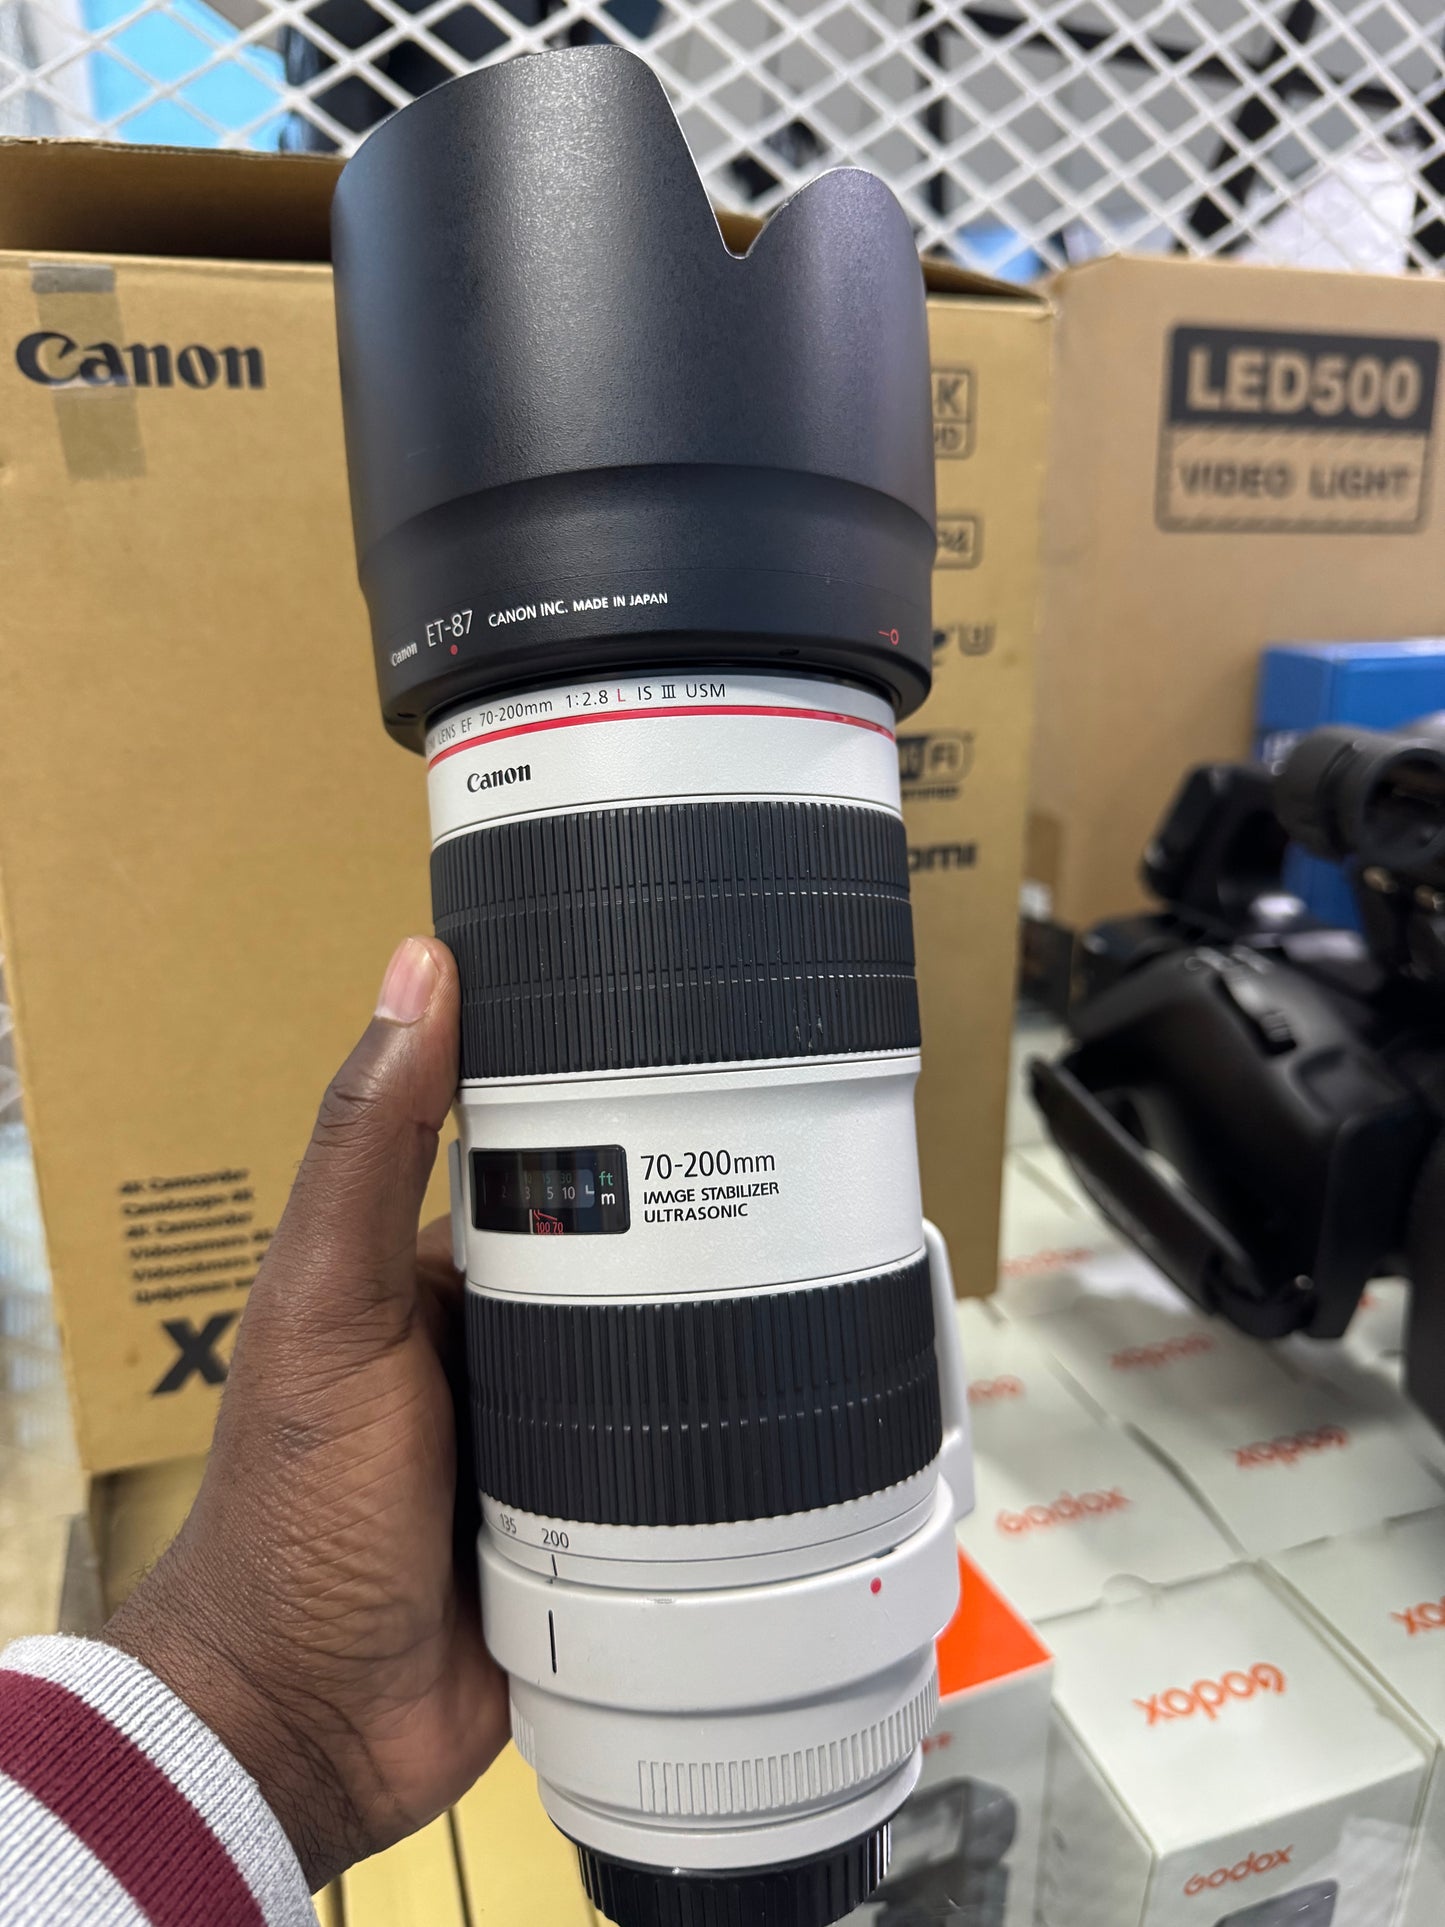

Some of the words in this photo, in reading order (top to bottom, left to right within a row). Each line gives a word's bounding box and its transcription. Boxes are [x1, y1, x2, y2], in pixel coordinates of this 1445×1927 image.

[15, 331, 266, 389] Canon
[936, 377, 963, 416] K
[1187, 347, 1421, 419] LED500
[1179, 461, 1296, 499] VIDEO
[1308, 463, 1411, 499] LIGHT
[390, 642, 418, 667] Canon
[425, 609, 474, 648] ET-87
[488, 604, 537, 628] CANON
[540, 600, 569, 617] INC.
[573, 597, 609, 612] MADE
[613, 595, 626, 607] IN
[630, 592, 668, 607] JAPAN
[438, 724, 457, 744] LENS
[461, 717, 473, 733] EF
[480, 700, 553, 727] 70-200mm
[566, 689, 609, 709] 1:2.8
[617, 688, 626, 703] L
[637, 685, 652, 701] IS
[686, 683, 726, 699] USM
[467, 763, 532, 793] Canon
[598, 1170, 614, 1187] ft
[640, 1149, 776, 1181] 70-200mm
[546, 1186, 554, 1200] 5
[562, 1186, 576, 1200] 10
[601, 1192, 616, 1205] m
[643, 1188, 696, 1205] IMAGE
[701, 1181, 780, 1202] STABILIZER
[535, 1221, 550, 1234] 100
[552, 1221, 564, 1234] 70
[644, 1203, 748, 1223] ULTRASONIC
[500, 1512, 517, 1534] 135
[541, 1527, 570, 1549] 200
[996, 1487, 1132, 1536] Godox
[1132, 1661, 1287, 1727] Godox
[1183, 1844, 1295, 1897] Godox
